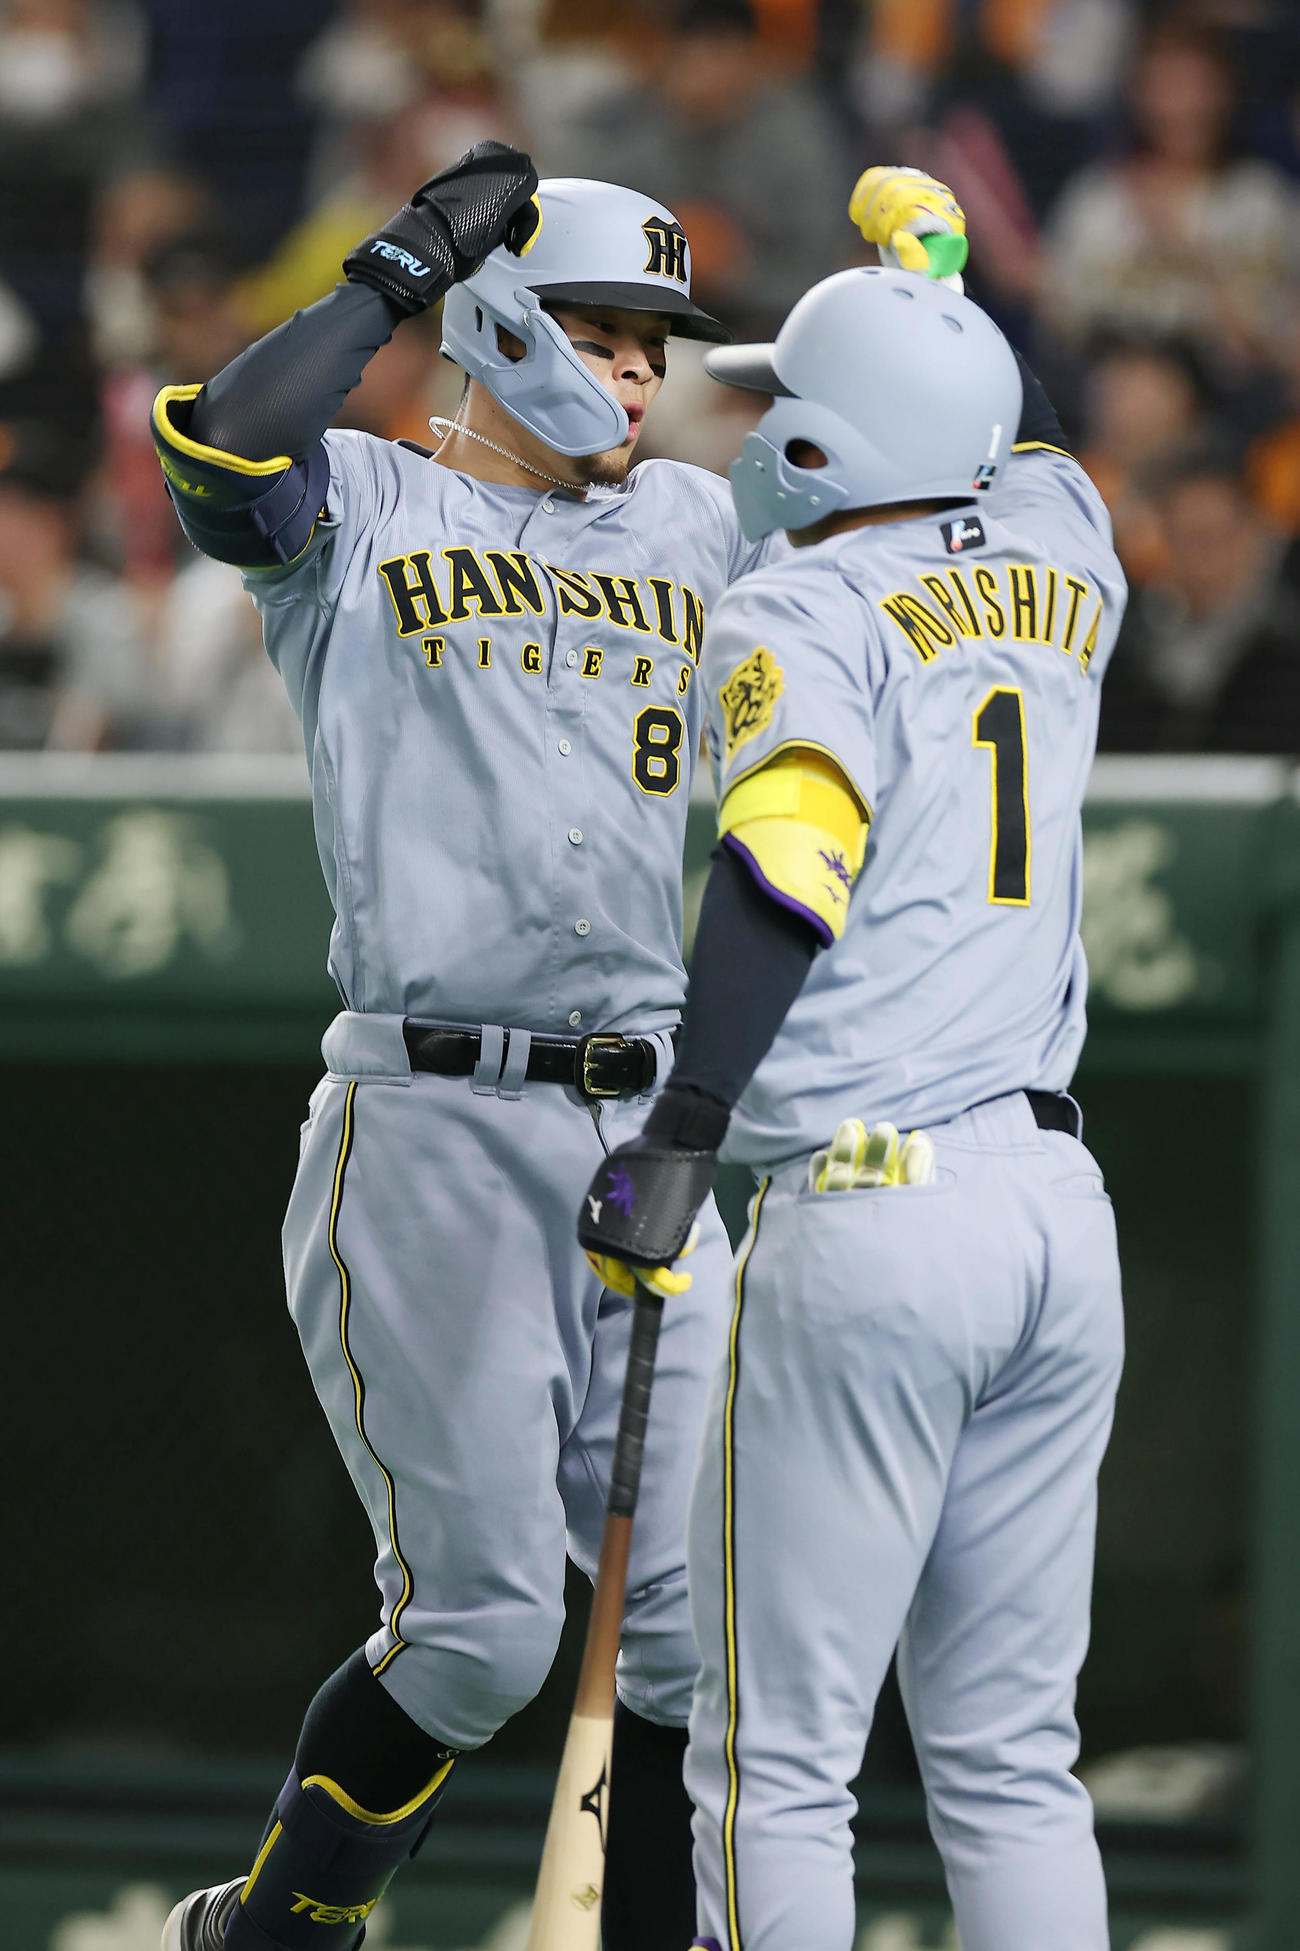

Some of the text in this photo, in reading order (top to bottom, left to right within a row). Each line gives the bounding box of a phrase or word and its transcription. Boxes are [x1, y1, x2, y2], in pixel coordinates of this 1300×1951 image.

[987, 423, 1003, 460] 1
[378, 546, 705, 670] HANSHIN
[421, 636, 691, 696] TIGERS
[631, 704, 684, 797] 8
[971, 684, 1032, 907] 1
